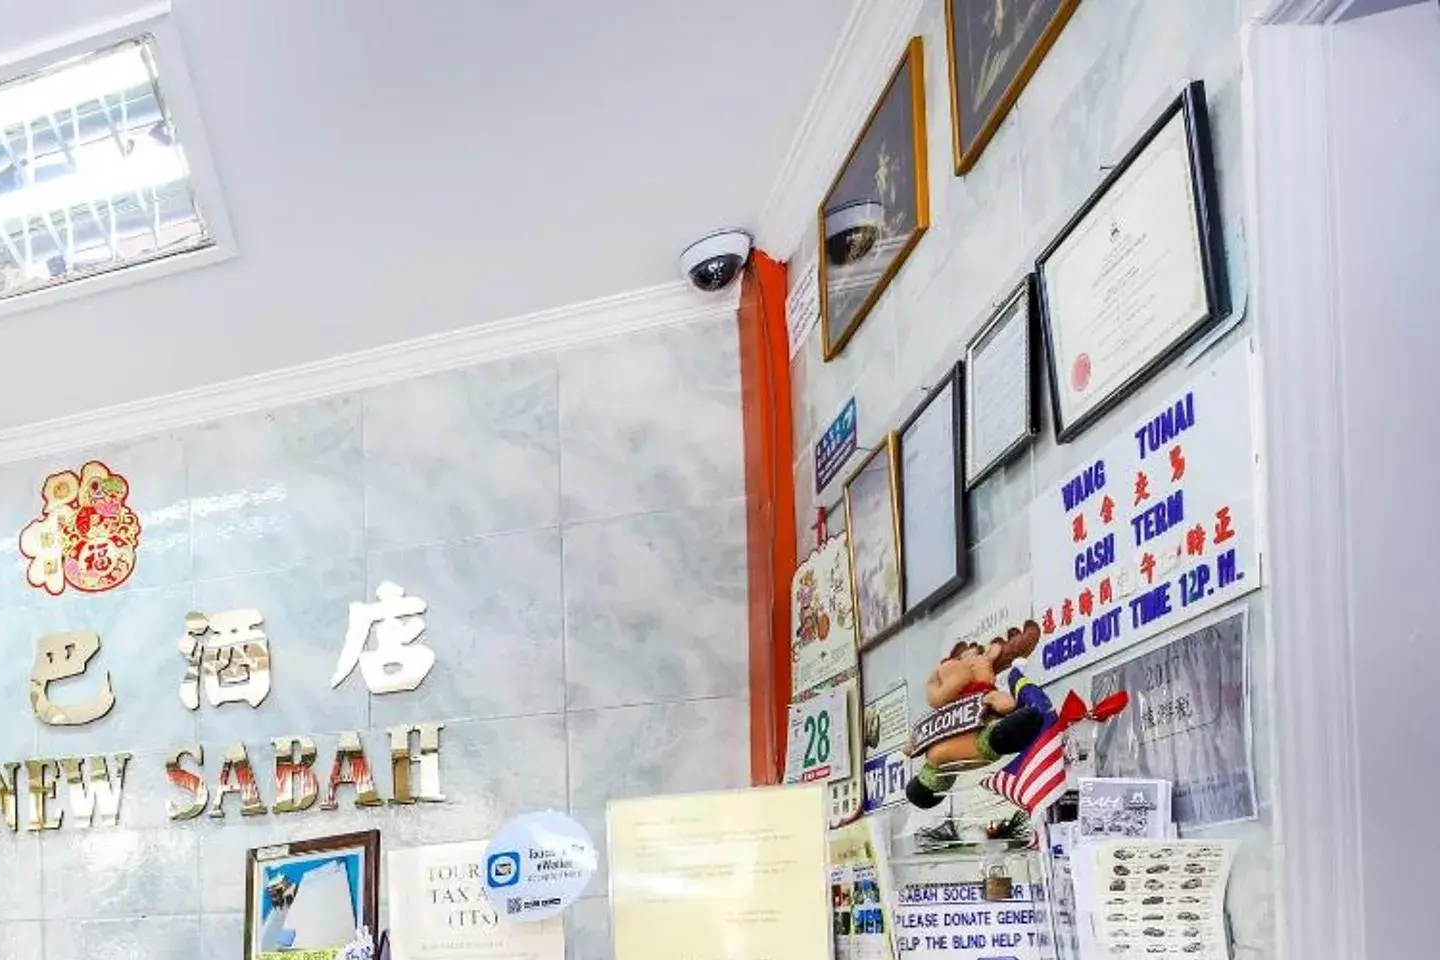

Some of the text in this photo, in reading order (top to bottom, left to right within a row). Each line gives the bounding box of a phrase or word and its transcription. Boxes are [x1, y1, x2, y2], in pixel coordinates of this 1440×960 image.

[1061, 392, 1195, 512] WANG TUNAI
[1075, 489, 1184, 581] CASH TERM
[1042, 626, 1086, 670] CHECK
[1092, 606, 1122, 647] OUT
[1129, 581, 1172, 629] TIME
[803, 709, 831, 769] 28
[165, 723, 448, 820] SABAH
[432, 887, 470, 904] TAX
[899, 887, 938, 903] SABAH
[944, 885, 986, 901] SOCIET
[944, 911, 991, 926] DONATE
[896, 936, 921, 951] ELP
[925, 935, 947, 949] THE
[952, 934, 986, 949] BLIND
[992, 932, 1022, 947] HELP
